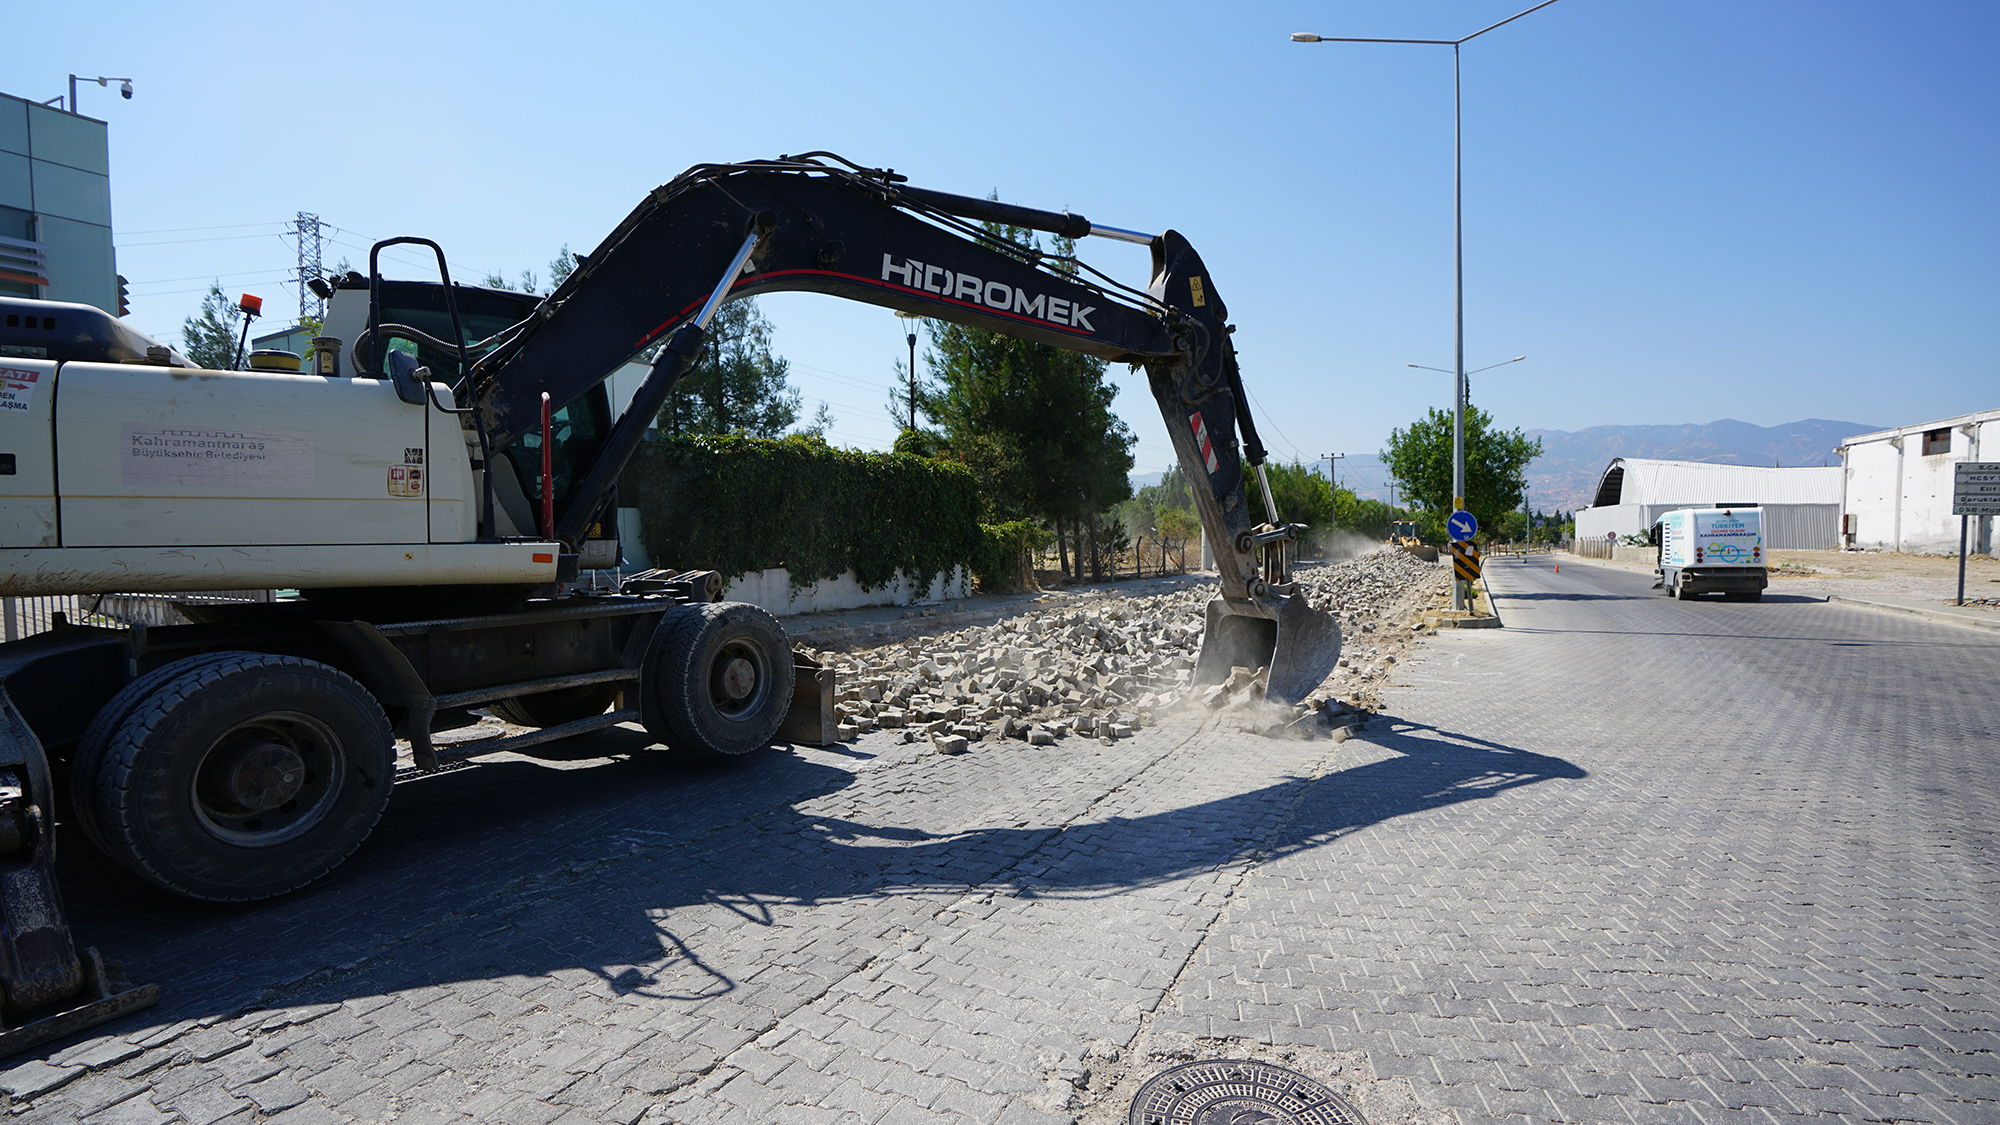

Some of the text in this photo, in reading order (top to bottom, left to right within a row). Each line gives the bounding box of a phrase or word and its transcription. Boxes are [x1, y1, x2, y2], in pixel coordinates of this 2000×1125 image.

[132, 435, 265, 451] Kahramanmaraş
[132, 447, 265, 462] Büyükşehir Belediyesi
